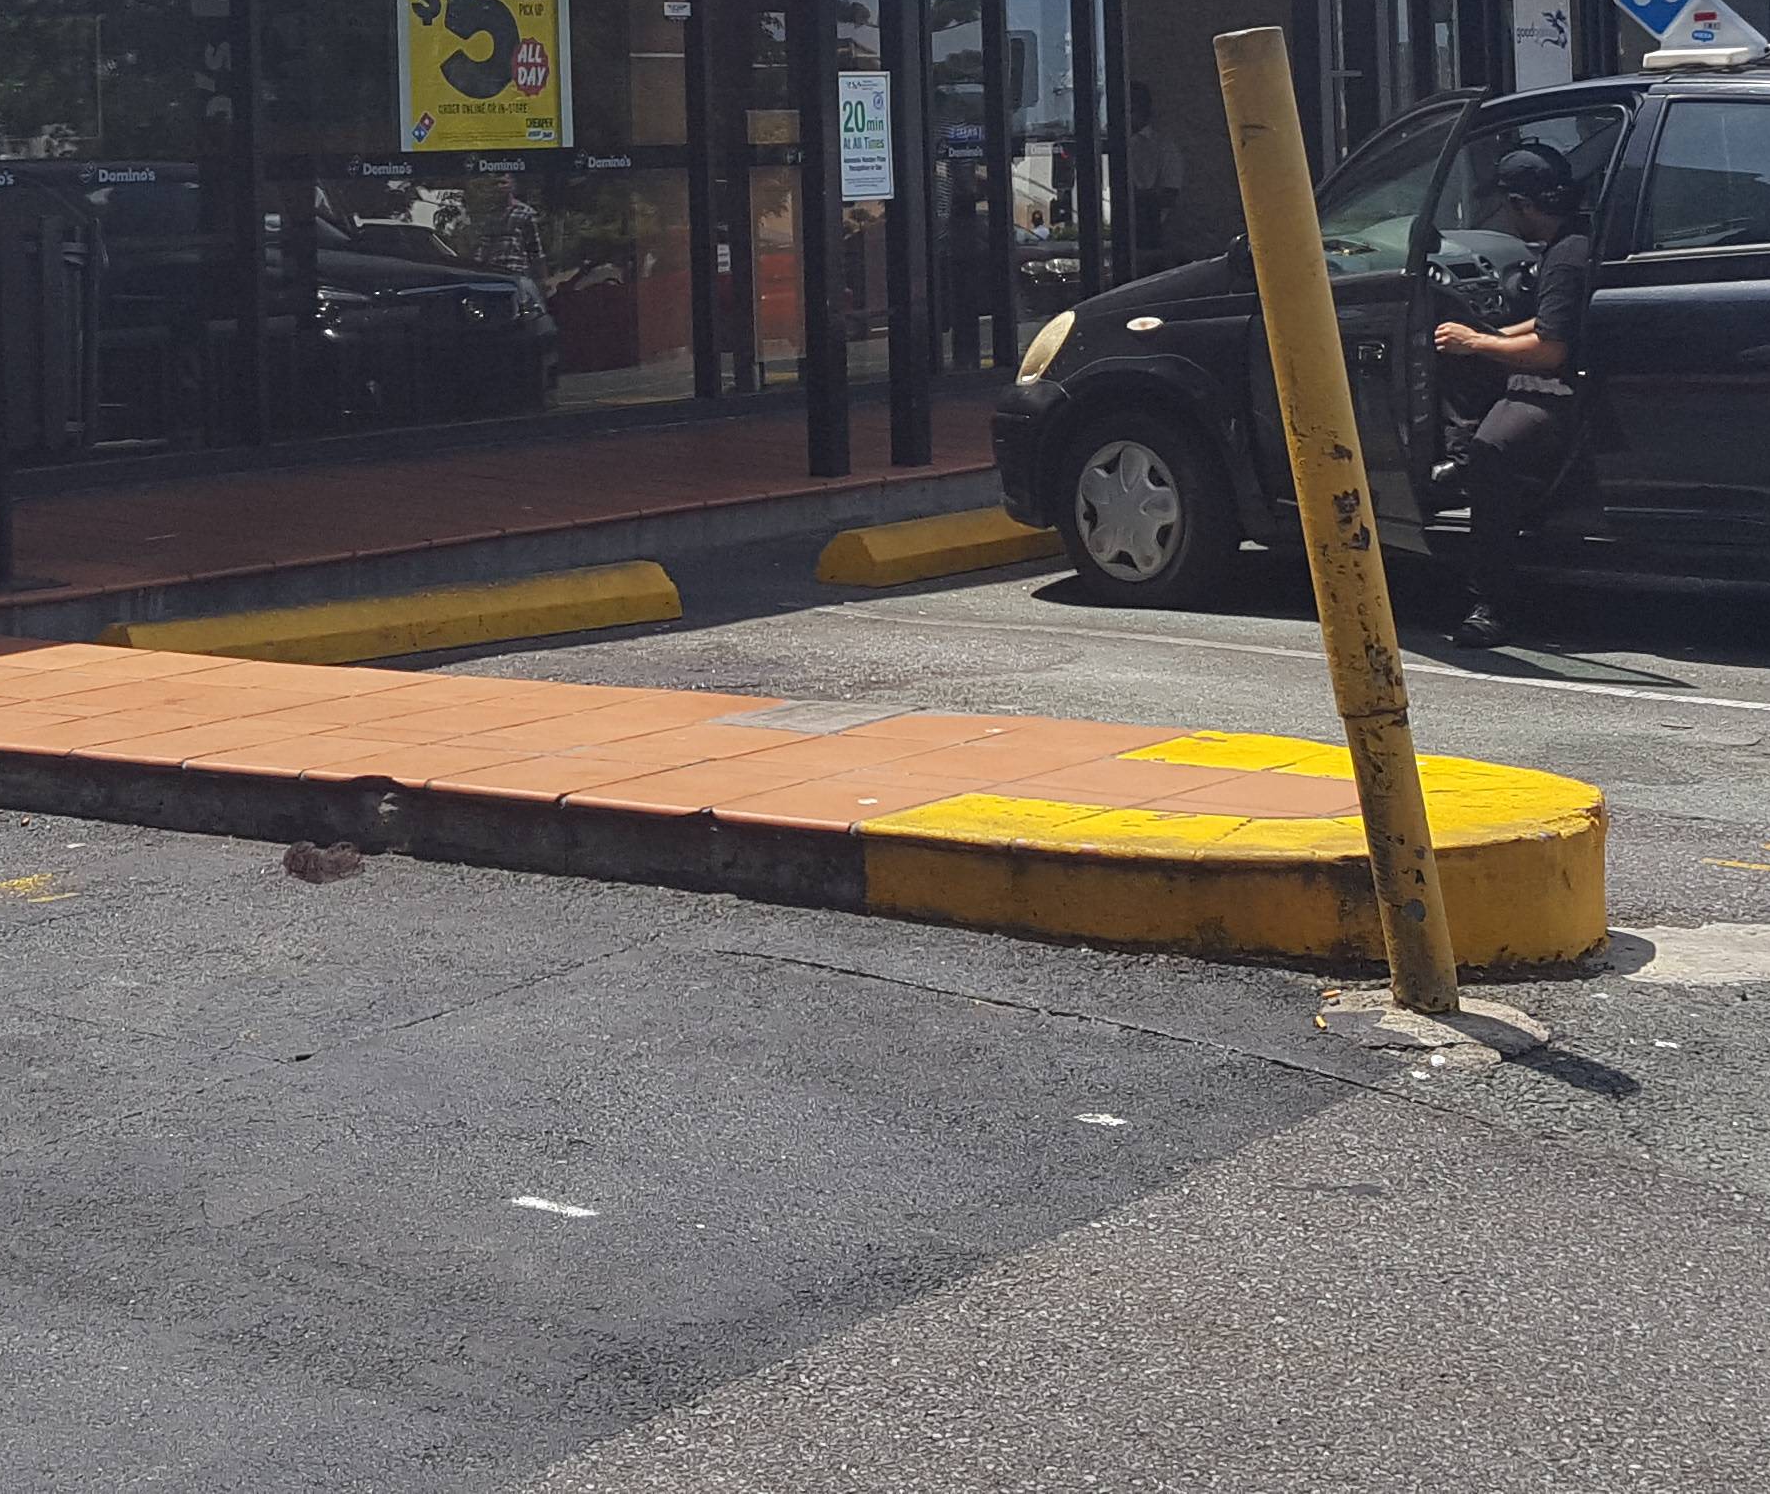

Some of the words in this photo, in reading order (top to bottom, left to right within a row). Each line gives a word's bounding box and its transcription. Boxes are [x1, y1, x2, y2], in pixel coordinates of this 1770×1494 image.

[518, 2, 533, 16] PICK
[534, 2, 544, 15] UP
[517, 43, 541, 63] ALL
[517, 66, 547, 86] DAY
[843, 100, 865, 133] 20
[866, 117, 884, 131] min
[362, 161, 413, 176] Domino's
[479, 158, 525, 172] Domino's
[587, 155, 632, 169] Domino's
[98, 167, 156, 183] Domino's
